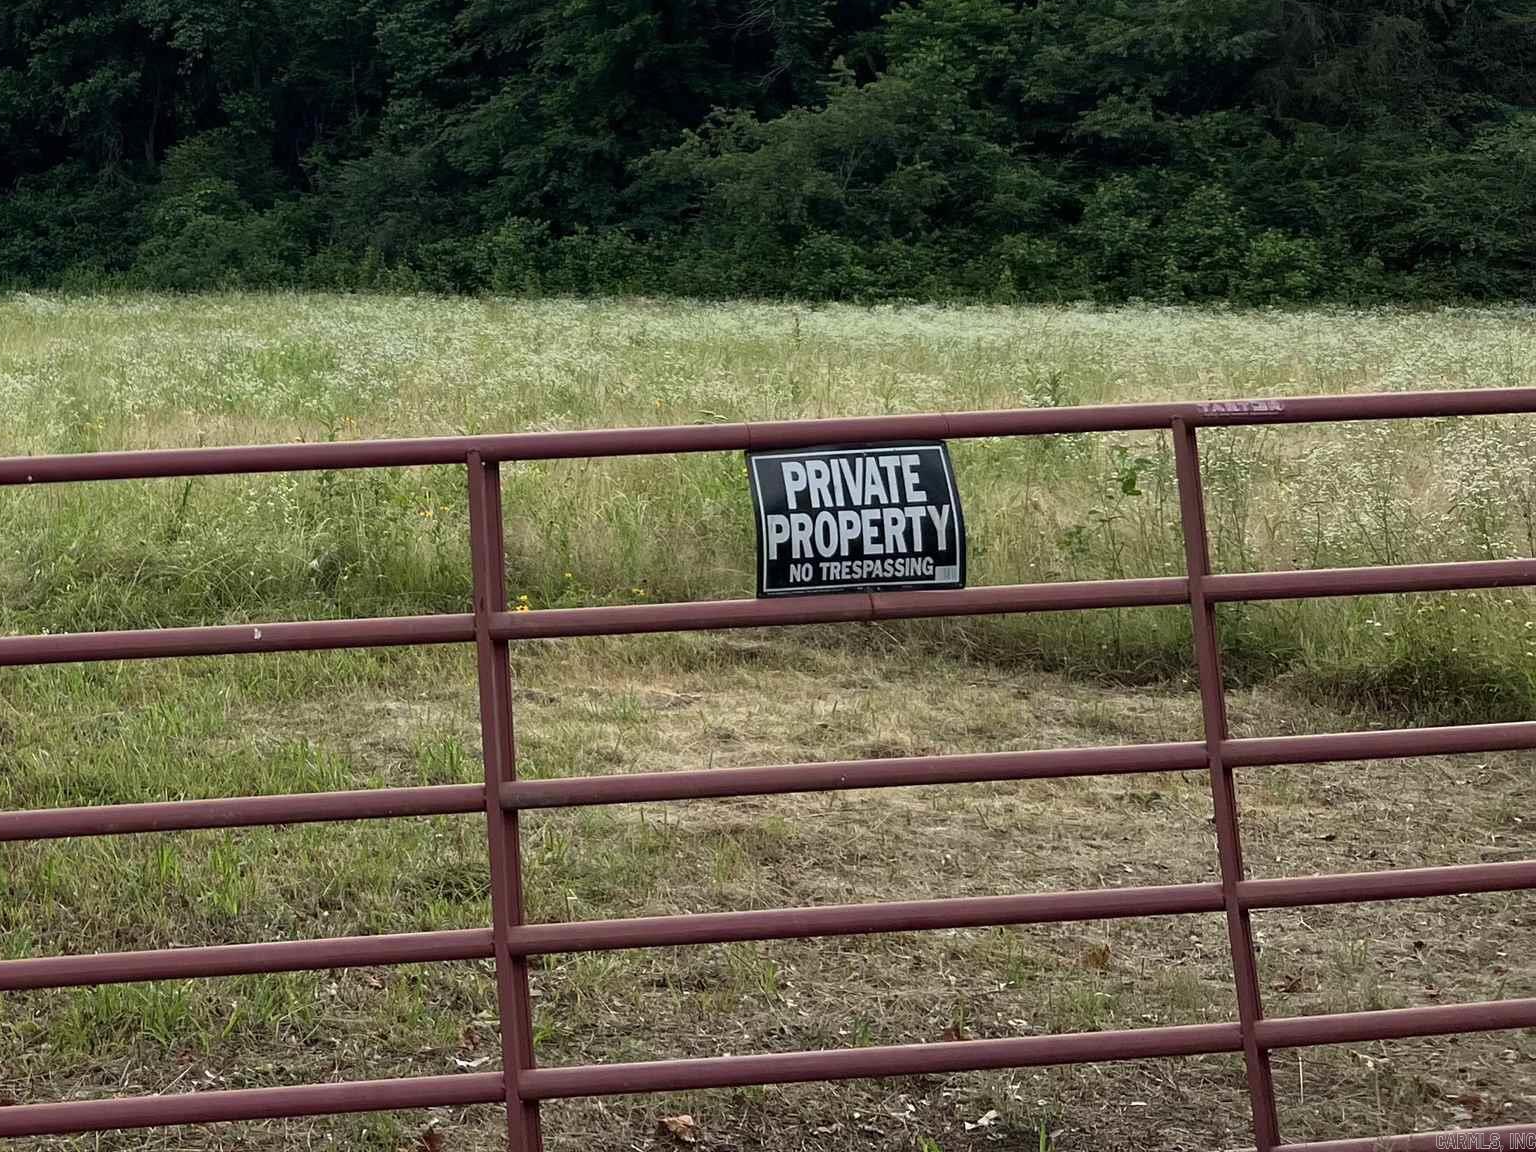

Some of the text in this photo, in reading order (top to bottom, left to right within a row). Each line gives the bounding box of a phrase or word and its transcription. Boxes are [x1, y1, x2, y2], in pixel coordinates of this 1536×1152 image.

[781, 454, 928, 510] PRIVATE
[766, 504, 950, 560] PROPERTY
[789, 556, 934, 583] NO TRESPASSING
